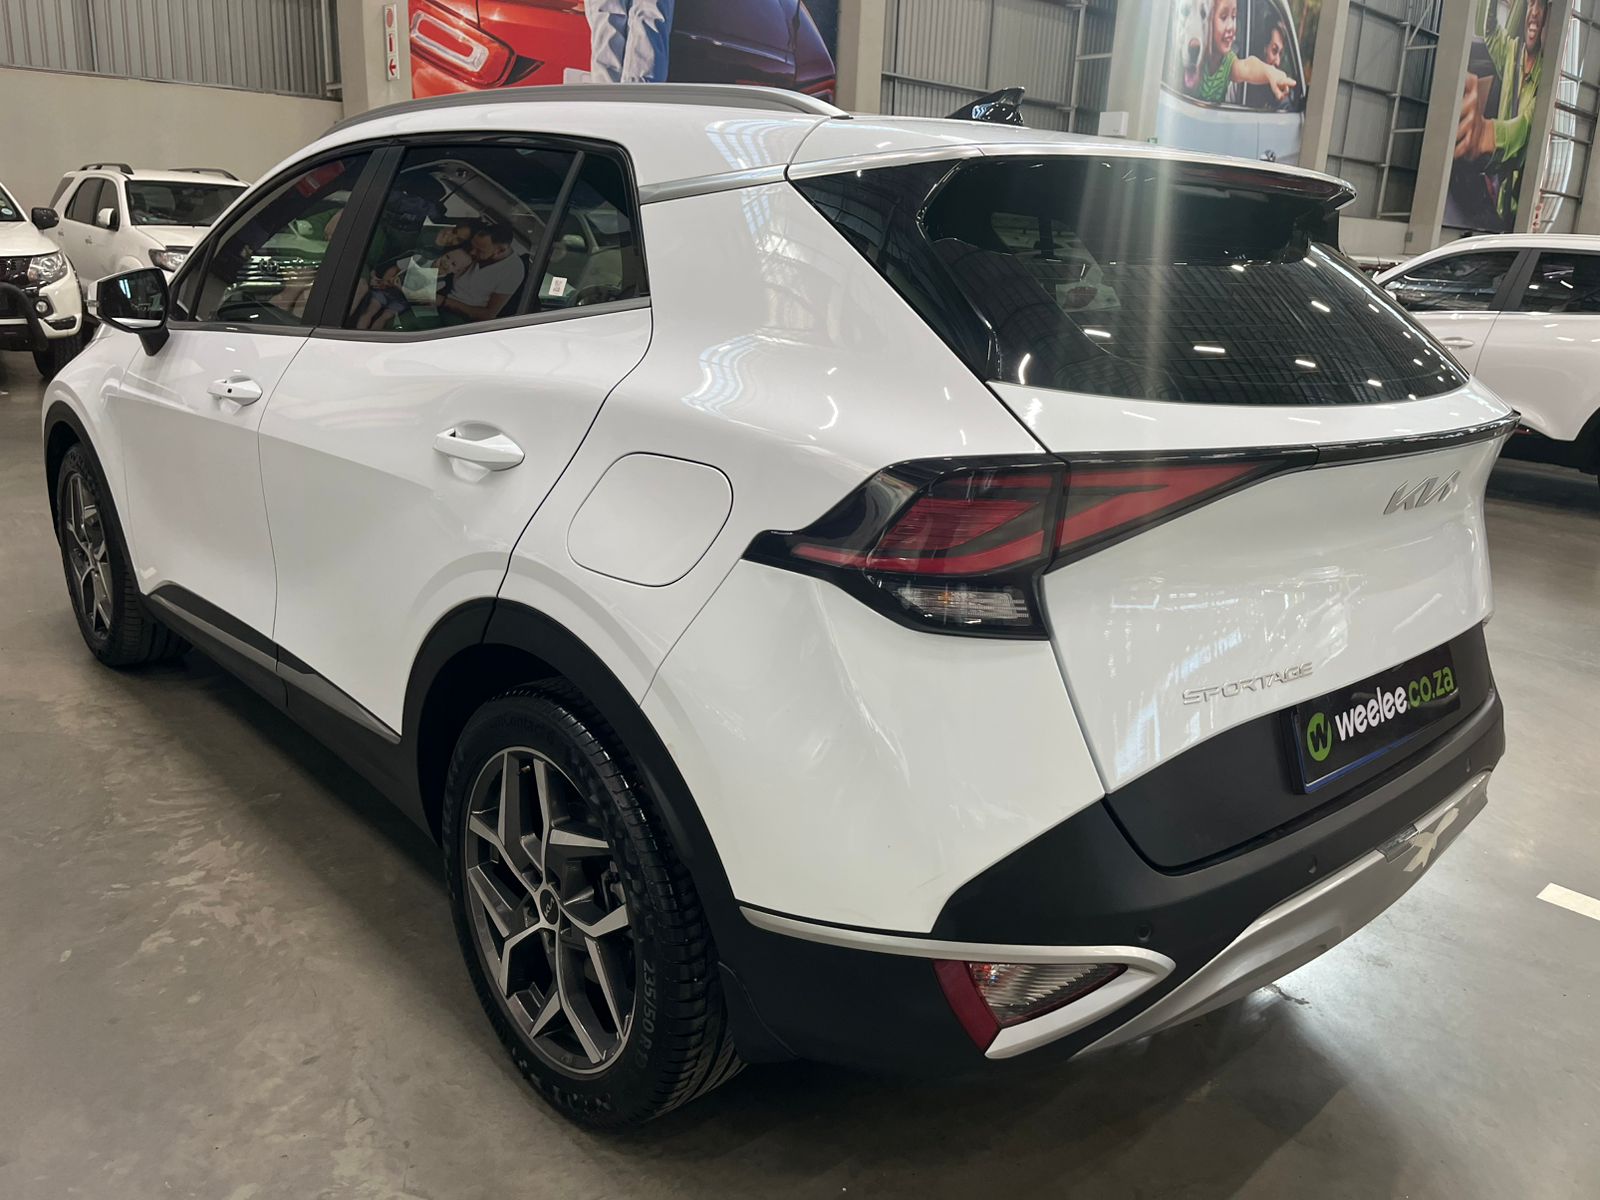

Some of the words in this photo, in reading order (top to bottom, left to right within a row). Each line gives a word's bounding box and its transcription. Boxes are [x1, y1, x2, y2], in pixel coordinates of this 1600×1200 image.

[1383, 469, 1460, 515] KIA
[1182, 662, 1313, 705] SPORTAGE
[1335, 666, 1454, 741] weelee.co.za
